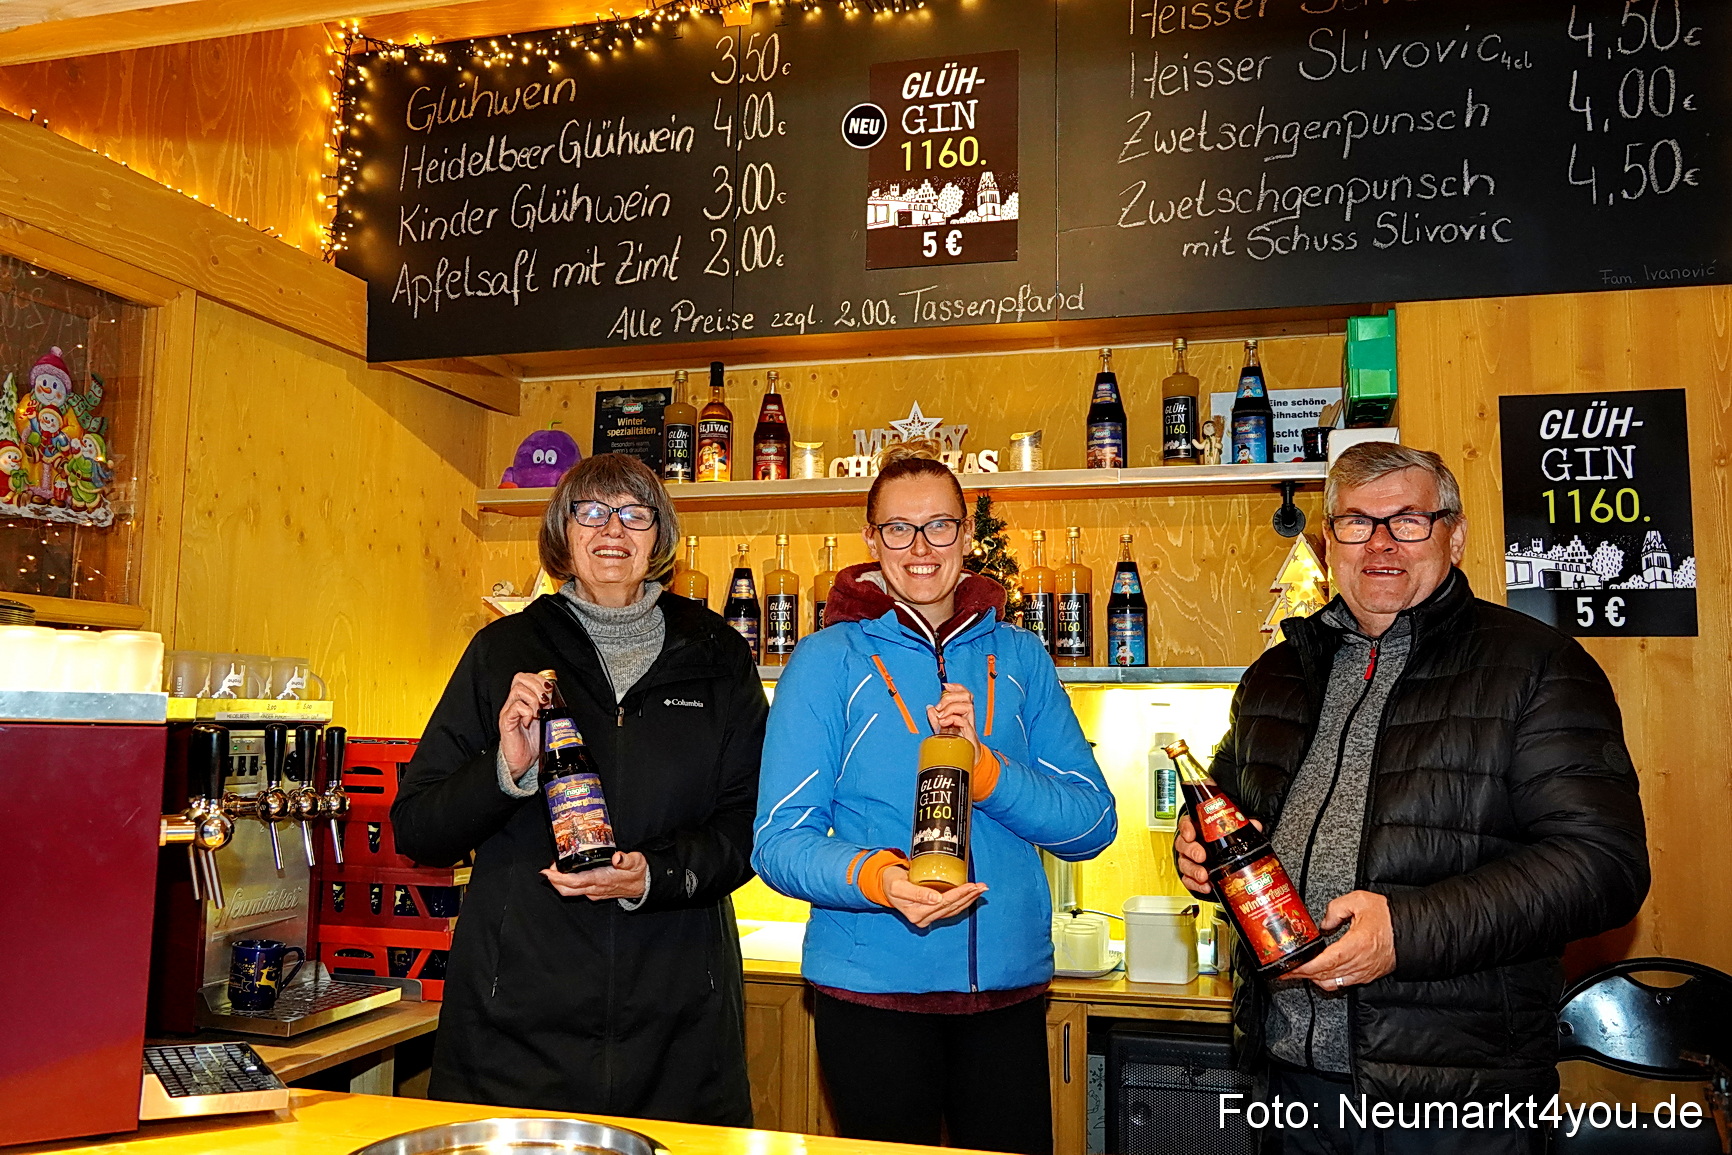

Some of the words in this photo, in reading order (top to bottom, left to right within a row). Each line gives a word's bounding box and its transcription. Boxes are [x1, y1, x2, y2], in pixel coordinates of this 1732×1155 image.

[709, 32, 792, 85] 3,50€
[1129, 50, 1273, 101] Heisser
[1298, 23, 1503, 82] Slivovic
[901, 62, 986, 101] GLÜH-
[1567, 65, 1698, 133] 4,00€
[405, 75, 577, 135] Glühwein
[712, 91, 787, 151] 4,00€
[901, 99, 979, 135] GIN
[558, 113, 696, 169] Glühwein
[848, 117, 881, 136] NEU
[1116, 88, 1491, 165] Zwetschgenpunsch
[900, 136, 987, 171] 1160.
[1567, 138, 1702, 206] 4,50€
[702, 162, 788, 224] 3,00€
[1116, 159, 1497, 229] Zwetschgenpunsch
[398, 203, 500, 247] Kinder
[510, 183, 672, 233] Glühwein
[702, 225, 786, 279] 2,00€
[922, 231, 938, 258] 5
[945, 229, 963, 256] €
[1182, 226, 1236, 260] mit
[1246, 219, 1359, 262] Schuss
[1372, 211, 1514, 251] Slivovic
[392, 249, 540, 319] Apfelsaft
[553, 246, 602, 290] mit
[614, 235, 683, 286] Zimt
[1598, 269, 1638, 285] Fam.
[1643, 259, 1719, 281] Ivanović
[606, 305, 663, 340] Alle
[672, 299, 754, 334] Preise
[770, 306, 824, 336] zzgl.
[833, 299, 898, 328] 2,00€
[898, 283, 1087, 325] Tassenpfand
[1165, 402, 1187, 414] GLÜH-
[1165, 413, 1185, 424] GIN
[1291, 398, 1327, 407] schöne
[1539, 400, 1644, 440] GLÜH-
[606, 426, 657, 438] spezialitäten
[617, 417, 647, 427] Winter-
[668, 429, 690, 440] GLÜH-
[699, 423, 729, 434] ŠLJIVAC
[668, 440, 688, 449] GIN
[1541, 445, 1637, 482] GIN
[1541, 487, 1651, 524] 1160.
[769, 600, 792, 611] GLÜH-
[769, 611, 791, 621] GIN
[1058, 600, 1082, 611] GLÜH-
[1058, 611, 1080, 621] GIN
[1576, 596, 1595, 628] 5
[1604, 596, 1626, 627] €
[671, 698, 704, 708] Columbia
[919, 790, 952, 807] GIN
[920, 774, 956, 793] GLÜH-
[918, 806, 955, 822] 1160.
